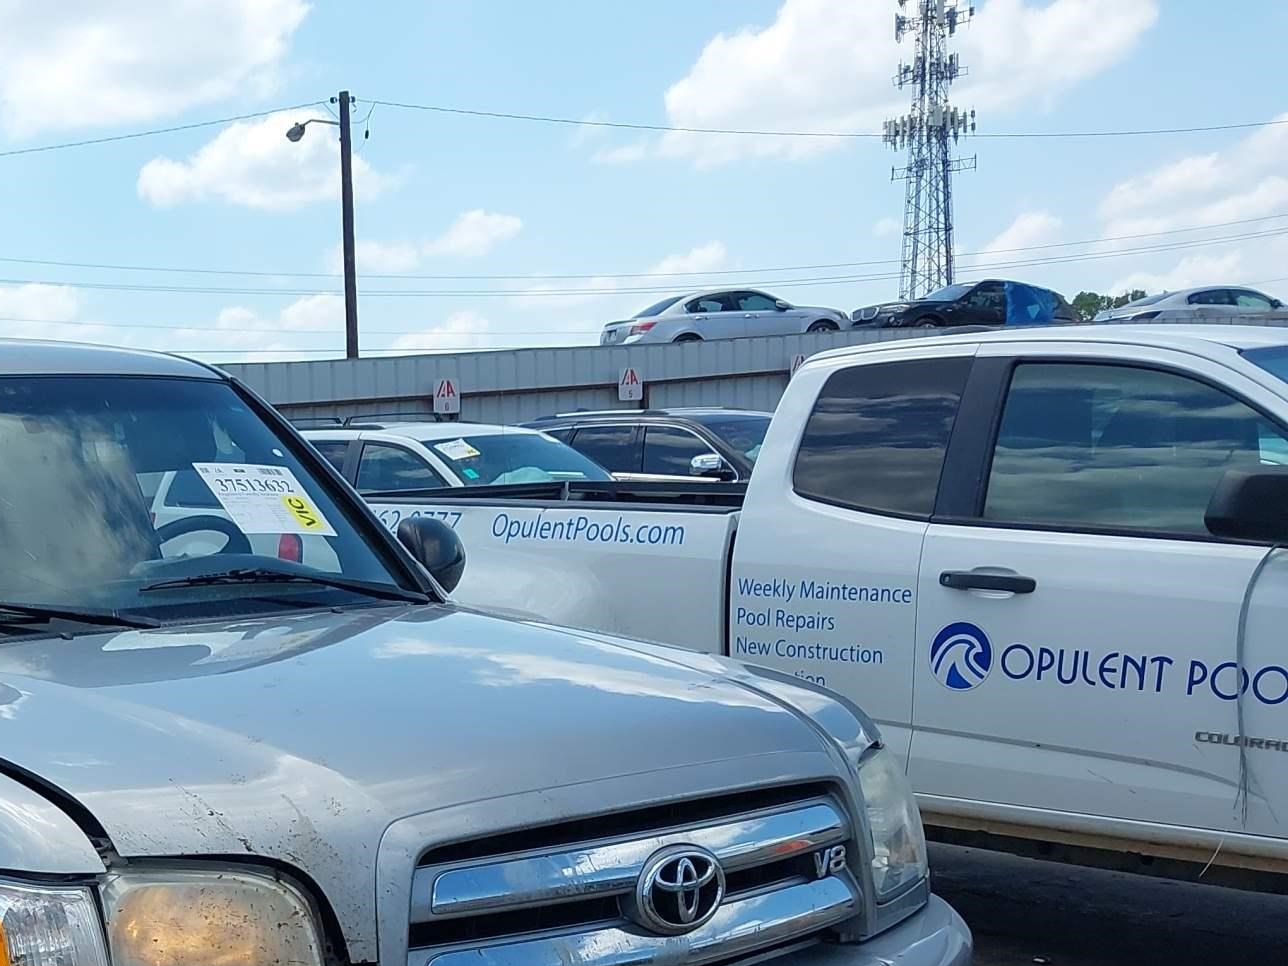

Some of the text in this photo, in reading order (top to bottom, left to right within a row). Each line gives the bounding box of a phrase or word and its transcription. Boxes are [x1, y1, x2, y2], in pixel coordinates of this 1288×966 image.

[628, 389, 633, 398] 5
[215, 478, 294, 493] 37513632
[491, 513, 685, 545] OpulentPools.com
[738, 578, 912, 603] Weekly Maintenance
[737, 608, 835, 632] Pool Repairs
[736, 637, 883, 664] New Construction
[1001, 643, 1173, 692] OPULENT
[814, 844, 846, 878] V8
